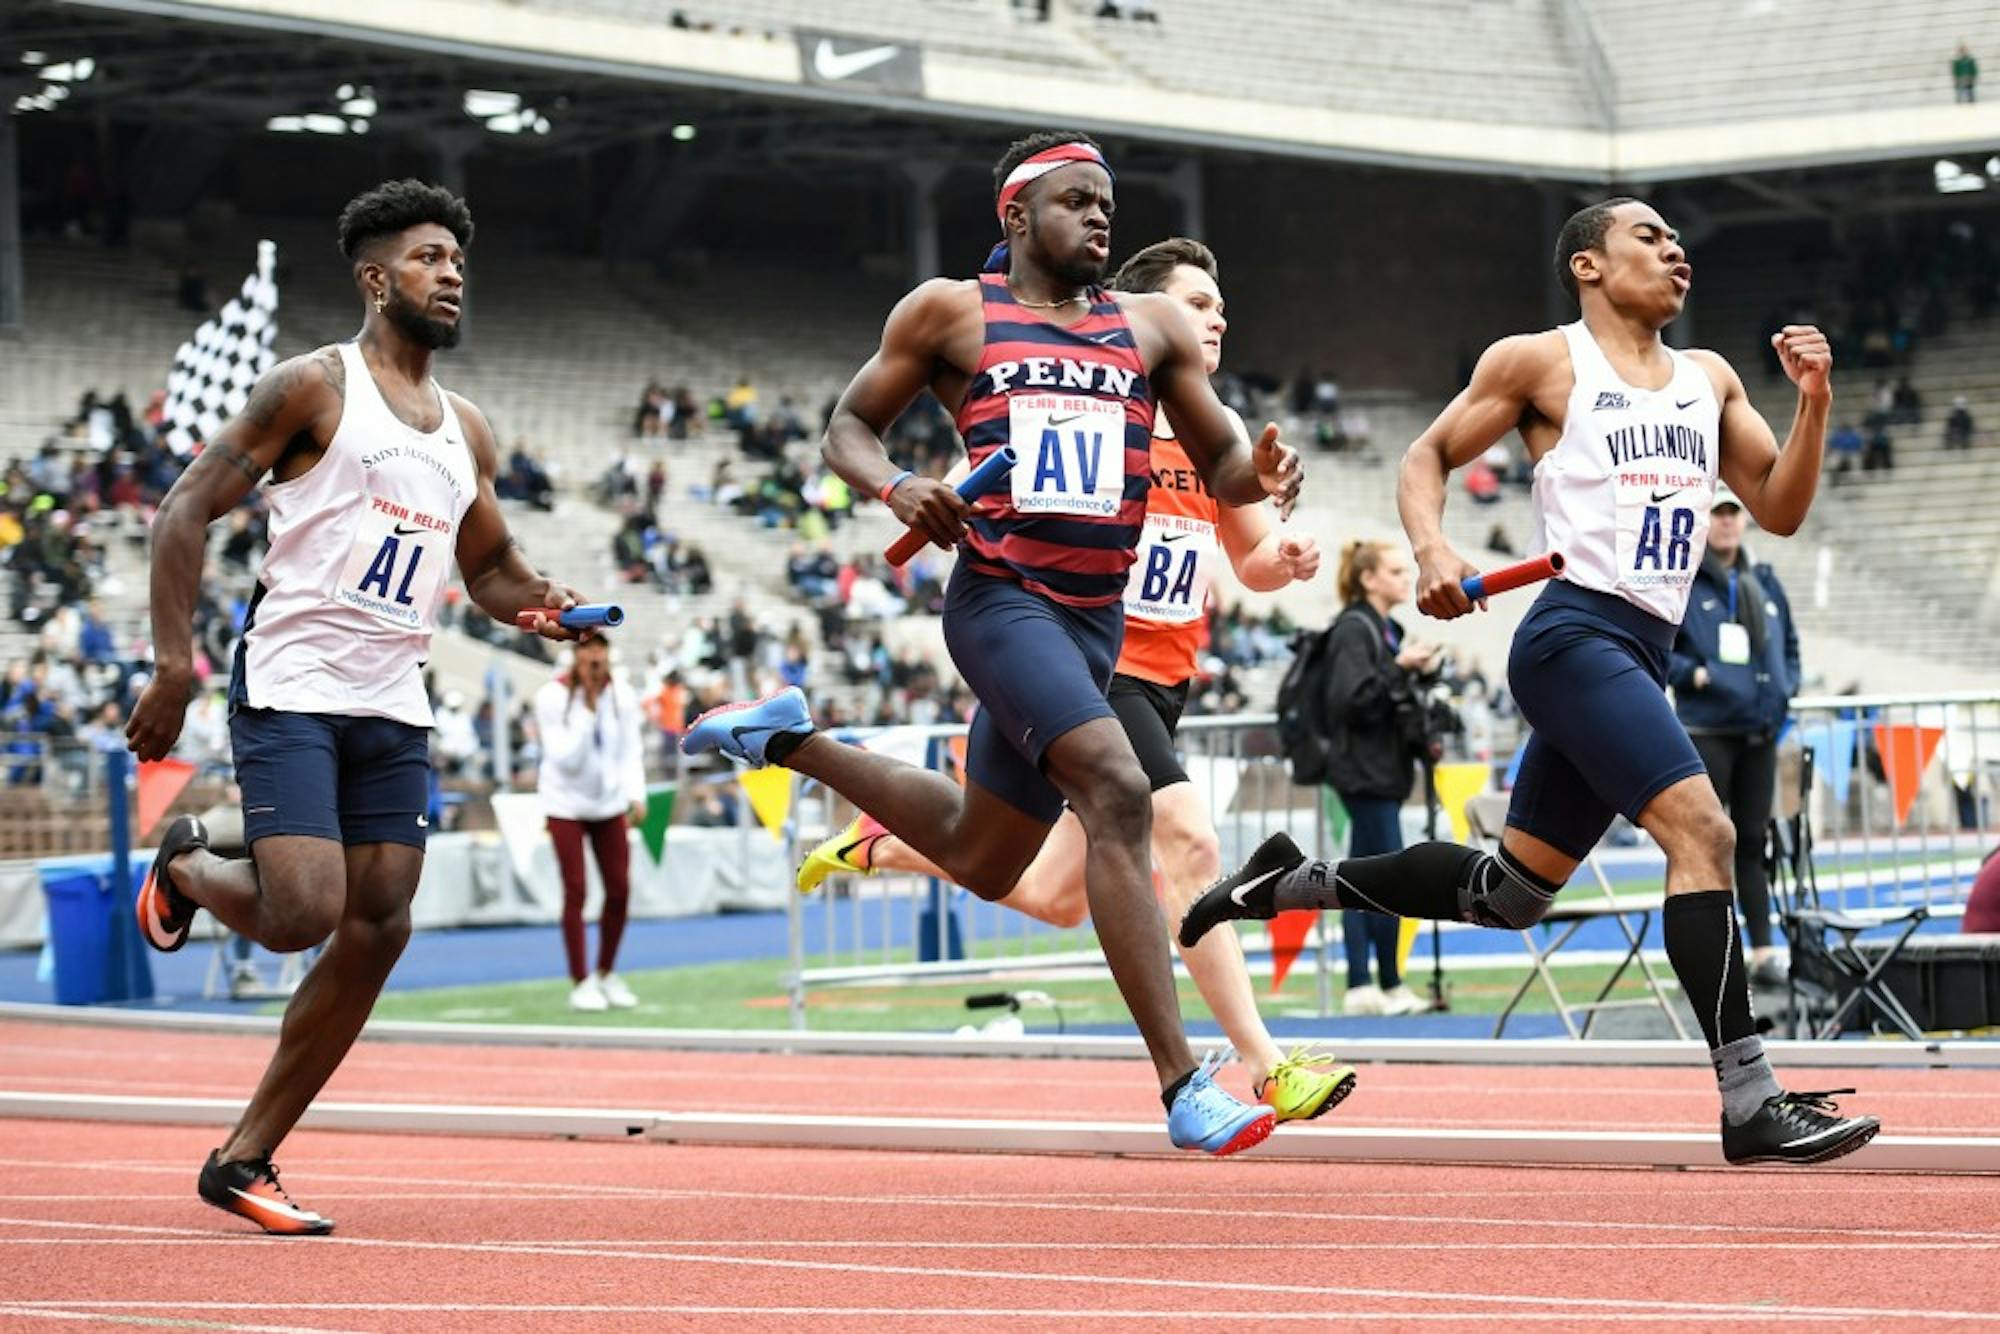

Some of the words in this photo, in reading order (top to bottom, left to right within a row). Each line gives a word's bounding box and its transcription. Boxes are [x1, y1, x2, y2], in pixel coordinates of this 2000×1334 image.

[985, 356, 1139, 398] PENN
[1016, 399, 1056, 410] PENN
[1064, 399, 1120, 415] RELAYS
[1033, 428, 1103, 495] AV
[1606, 423, 1707, 473] VILLANOVA
[1149, 468, 1200, 494] NCET
[1620, 473, 1658, 487] PENN
[372, 497, 409, 521] PENN
[412, 511, 451, 535] RELAYS
[1145, 516, 1170, 529] ENN
[1633, 505, 1695, 571] AR
[357, 535, 425, 606] AL
[1140, 544, 1199, 605] BA
